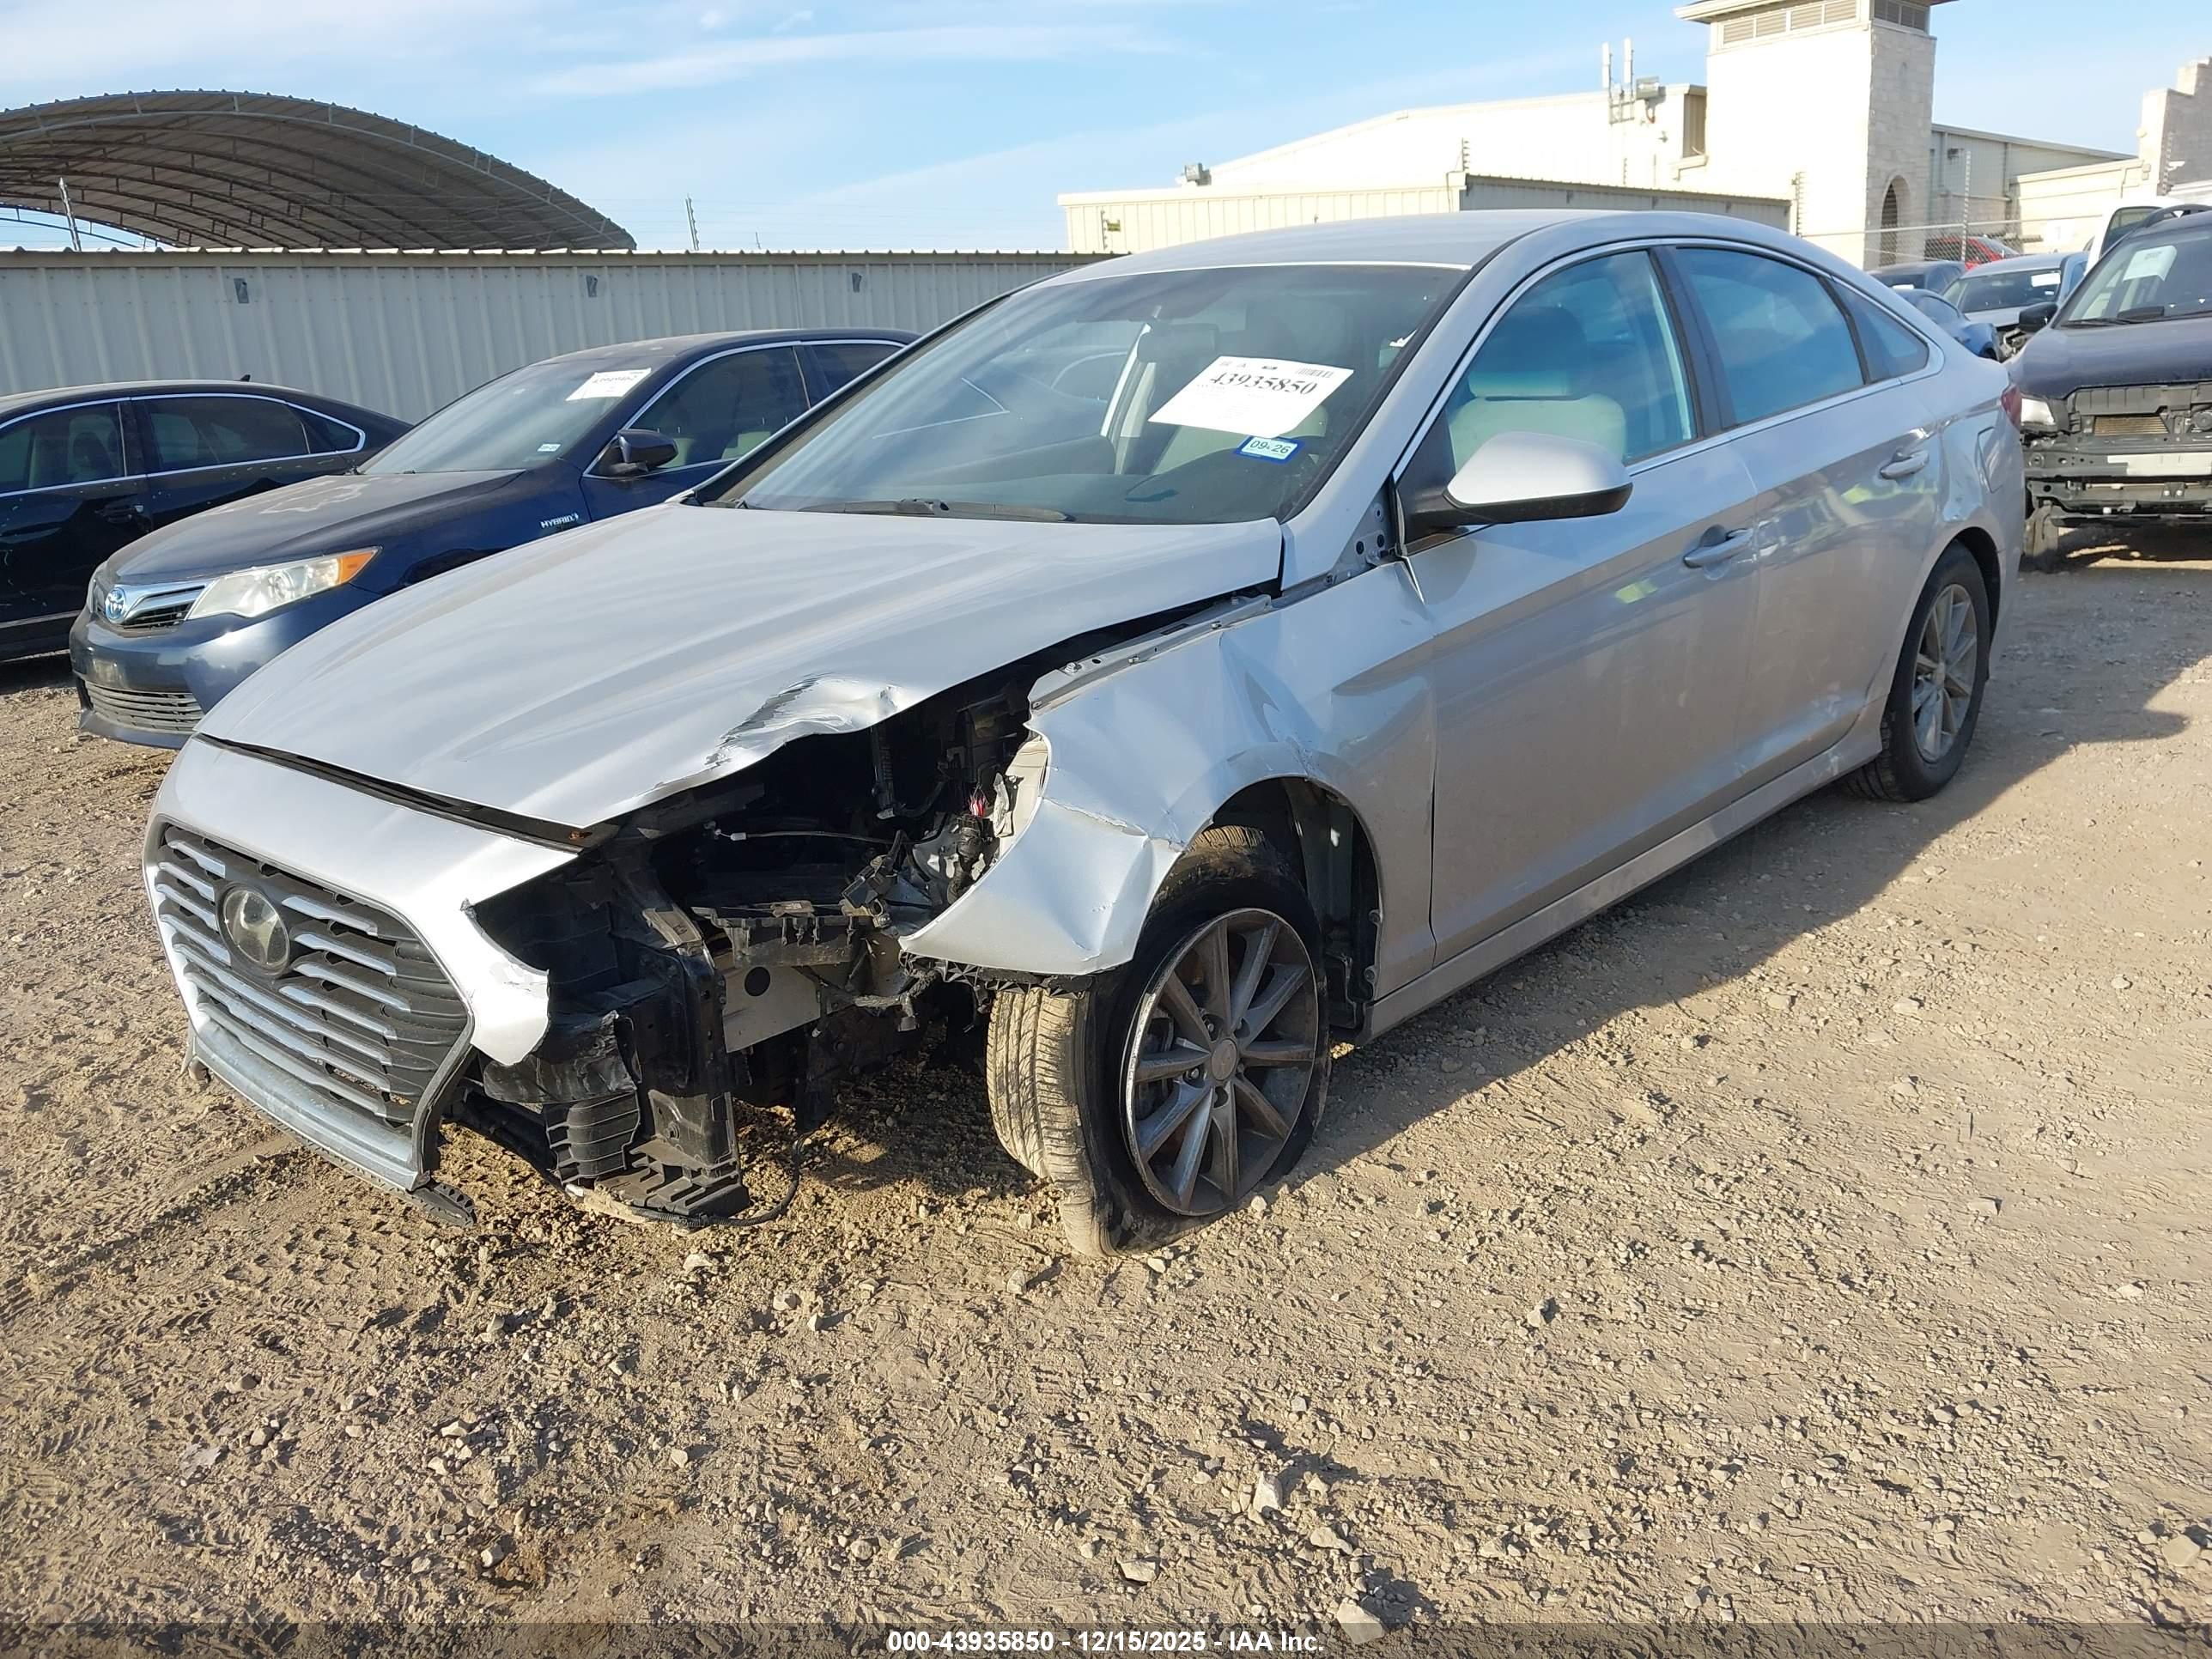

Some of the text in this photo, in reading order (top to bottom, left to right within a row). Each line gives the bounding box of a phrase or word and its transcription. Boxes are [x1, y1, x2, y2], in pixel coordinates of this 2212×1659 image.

[1209, 372, 1318, 395] 43935850
[1250, 440, 1291, 454] 09 26
